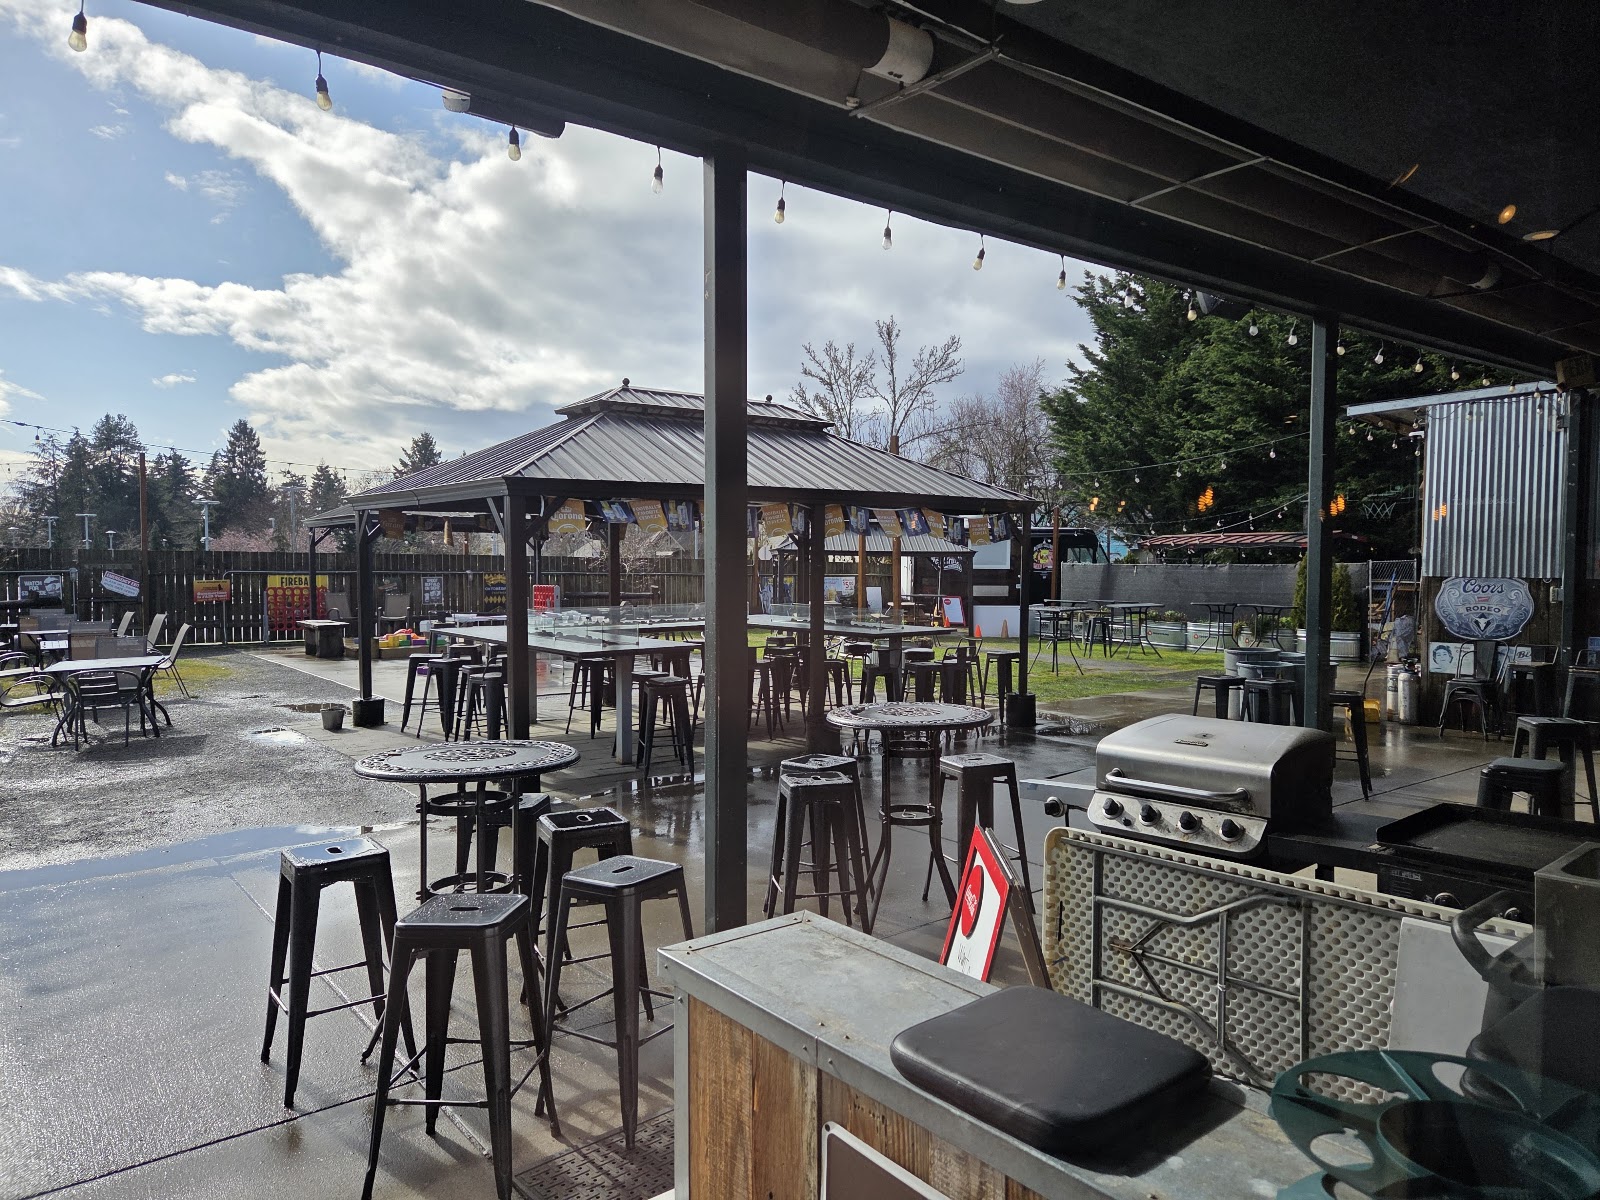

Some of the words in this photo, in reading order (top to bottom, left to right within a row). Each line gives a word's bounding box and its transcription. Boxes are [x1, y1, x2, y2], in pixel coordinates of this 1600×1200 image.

[280, 576, 309, 586] FIREBA
[1462, 578, 1505, 594] Coors
[1465, 605, 1502, 613] RODEO
